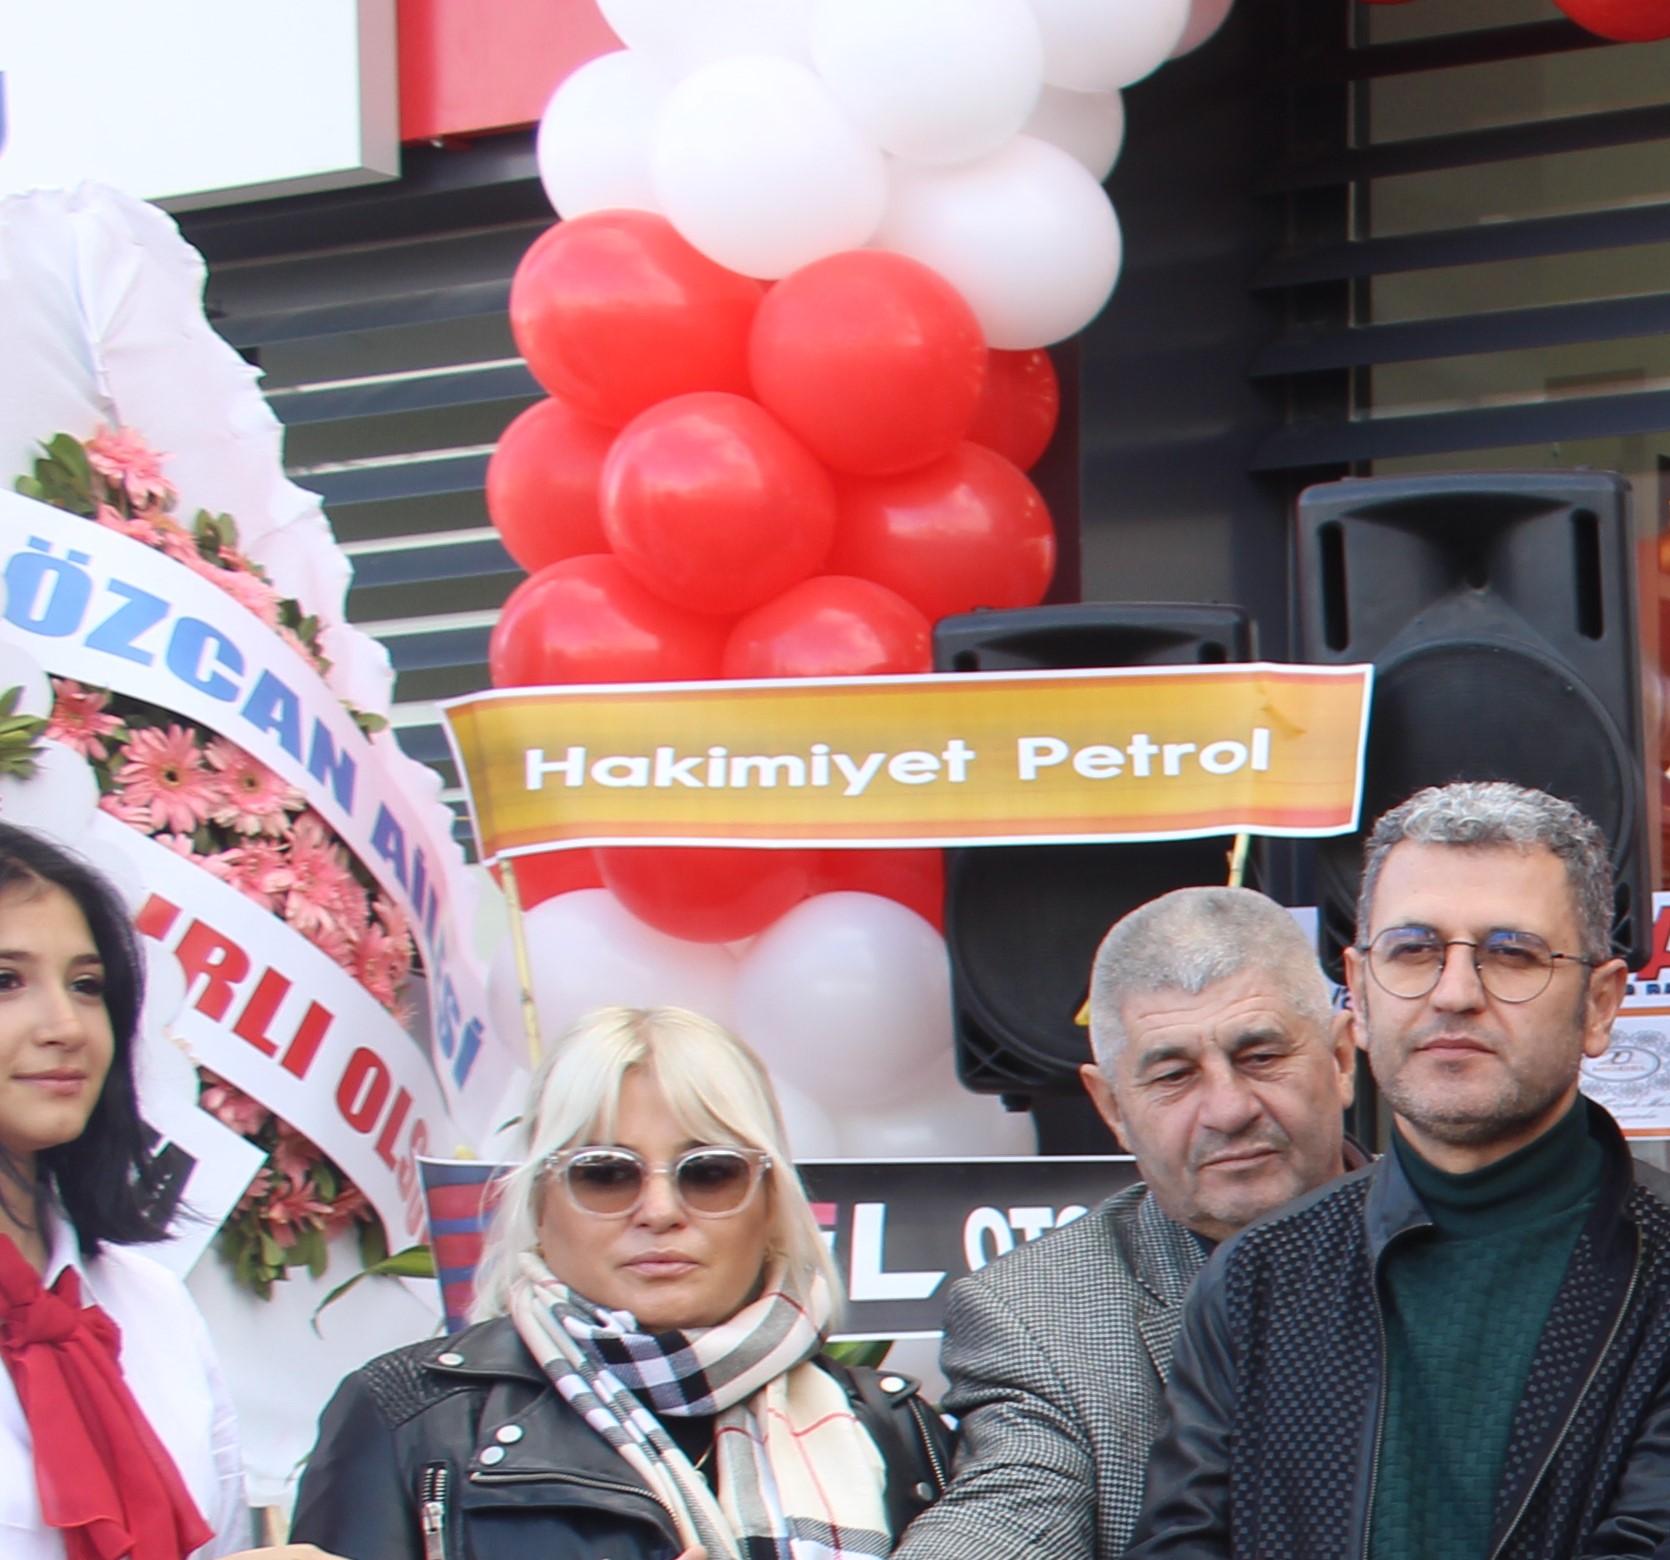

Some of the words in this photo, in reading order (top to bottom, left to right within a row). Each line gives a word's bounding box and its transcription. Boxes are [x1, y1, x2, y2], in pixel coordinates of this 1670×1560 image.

[4, 535, 357, 817] ÖZCAN
[525, 739, 975, 795] Hakimiyet
[1017, 728, 1270, 780] Petrol
